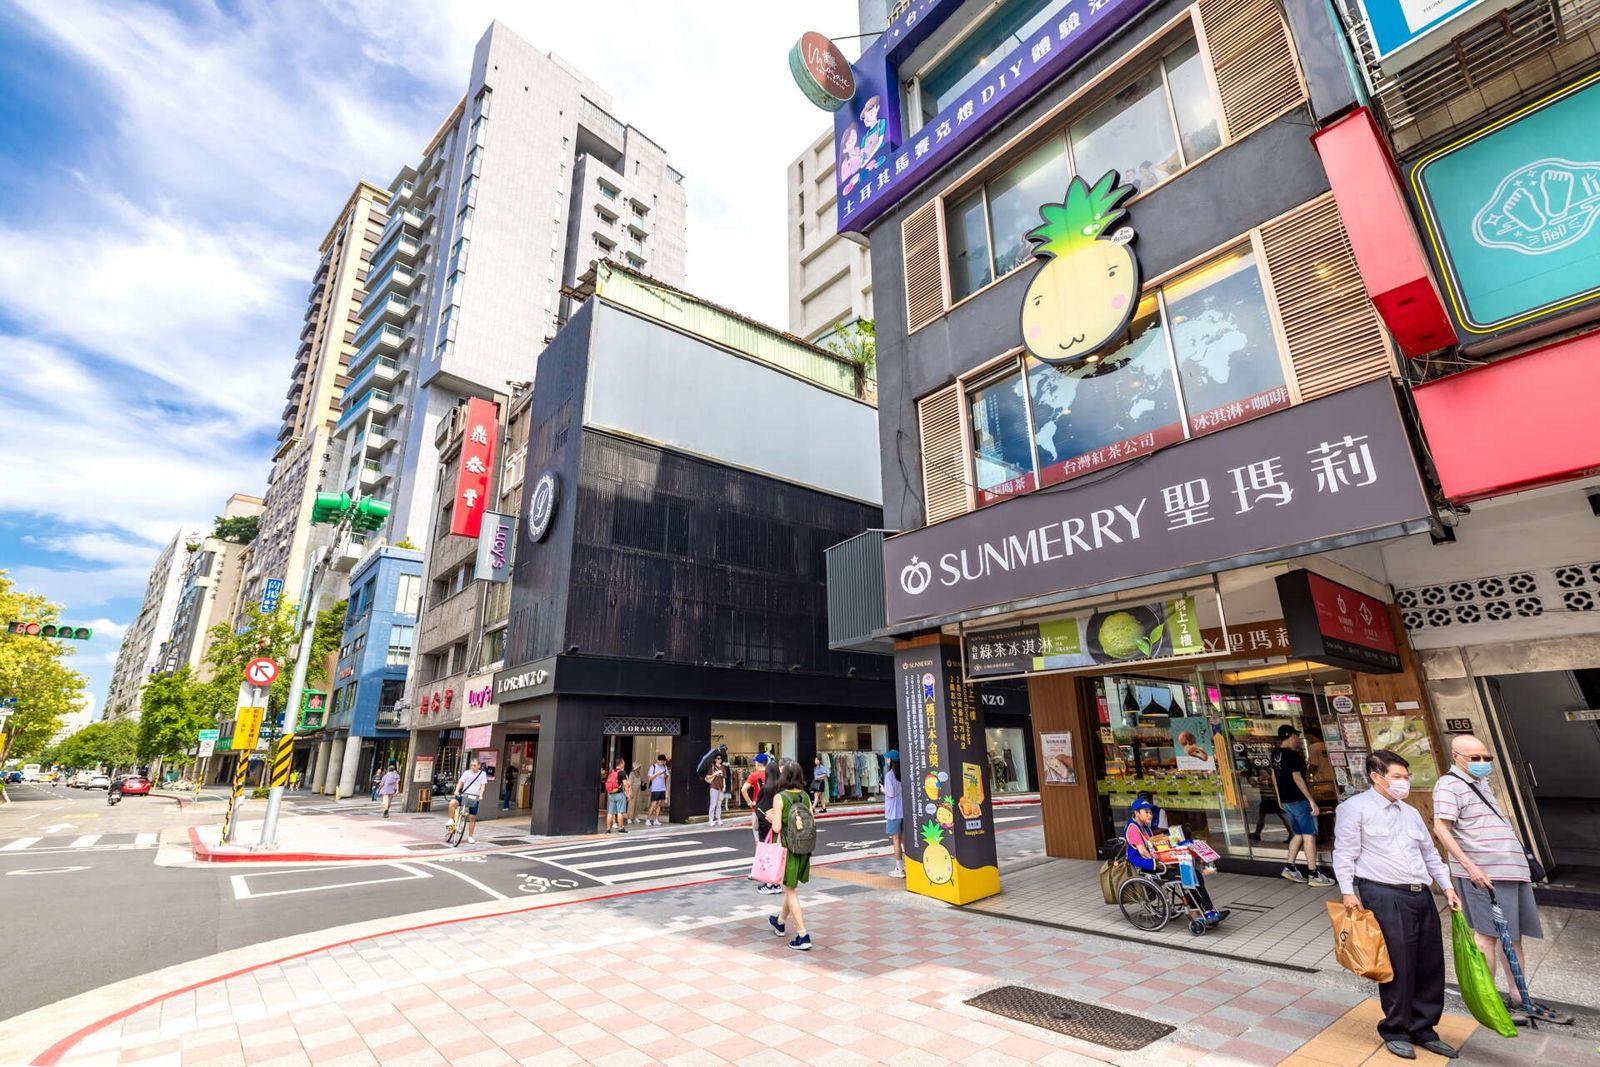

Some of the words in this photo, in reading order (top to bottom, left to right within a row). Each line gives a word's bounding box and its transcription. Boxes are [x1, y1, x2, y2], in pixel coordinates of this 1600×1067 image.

[1063, 433, 1155, 475] 台灣紅茶公司
[939, 498, 1147, 587] SUNMERRY
[1160, 434, 1379, 532] 聖瑪莉
[492, 524, 510, 569] Lucy's
[979, 636, 1053, 660] 綠茶冰淇淋
[498, 669, 545, 693] LORANZO
[1448, 719, 1470, 729] 186
